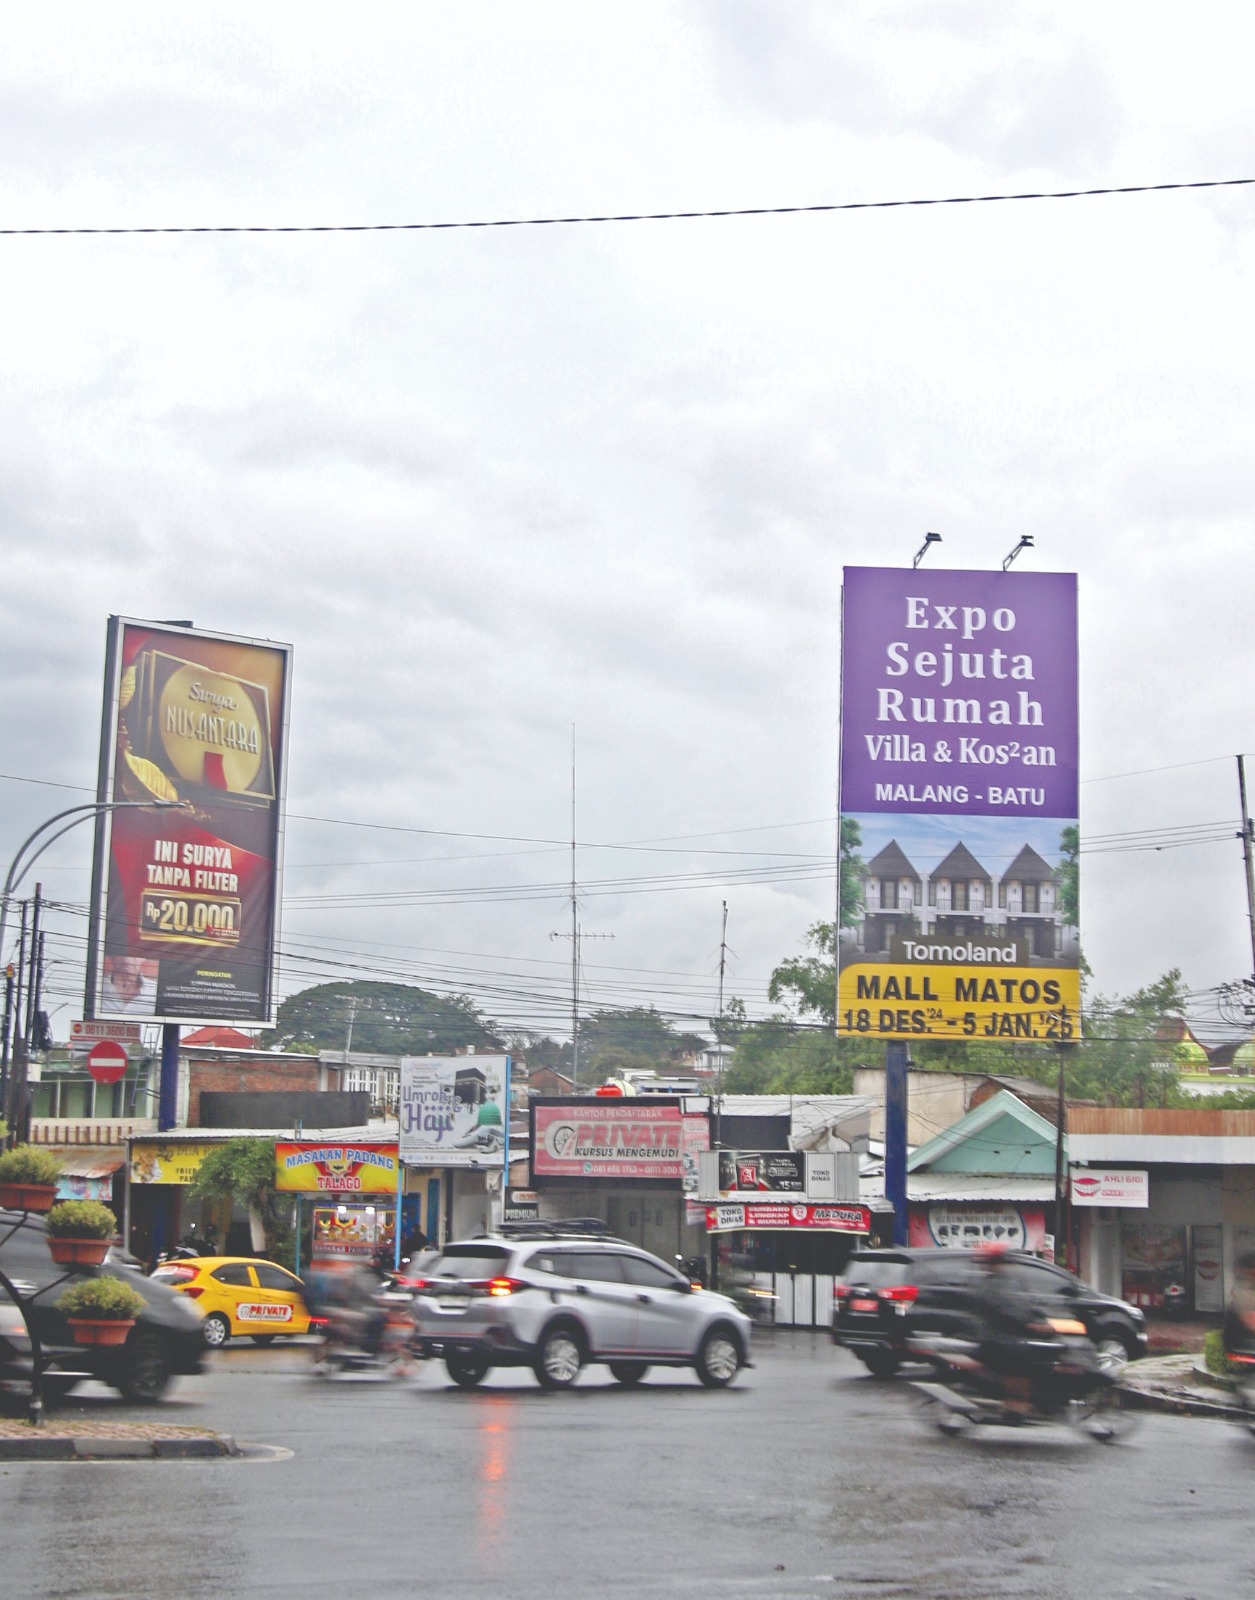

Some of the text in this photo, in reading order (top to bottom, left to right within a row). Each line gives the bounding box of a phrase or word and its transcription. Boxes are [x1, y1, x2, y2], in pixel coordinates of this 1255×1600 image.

[905, 597, 1016, 639] Expo
[886, 642, 1035, 687] Sejuta
[189, 682, 238, 713] Surya
[876, 688, 1044, 726] Rumah
[166, 705, 258, 754] NUSANTARA
[864, 734, 927, 762] Villa
[933, 740, 953, 763] &
[875, 783, 969, 803] MALANG
[988, 787, 1045, 805] BATU
[154, 839, 232, 869] INI SURYA
[147, 864, 238, 892] TANPA FILTER
[902, 941, 1017, 963] Tomoland
[856, 975, 1061, 1004] MALL MATOS
[844, 1009, 870, 1032] 18
[963, 1012, 977, 1035] 5
[577, 1124, 682, 1149] PRIVATE
[286, 1148, 394, 1170] MASAKAN PADANG
[574, 1147, 679, 1158] KURSUS MENGEMUDI
[317, 1176, 361, 1189] TALAGO
[721, 1208, 742, 1216] TOKO
[721, 1215, 744, 1224] DINAS
[813, 1208, 863, 1222] MADURA
[249, 1305, 288, 1317] PRIVATE
